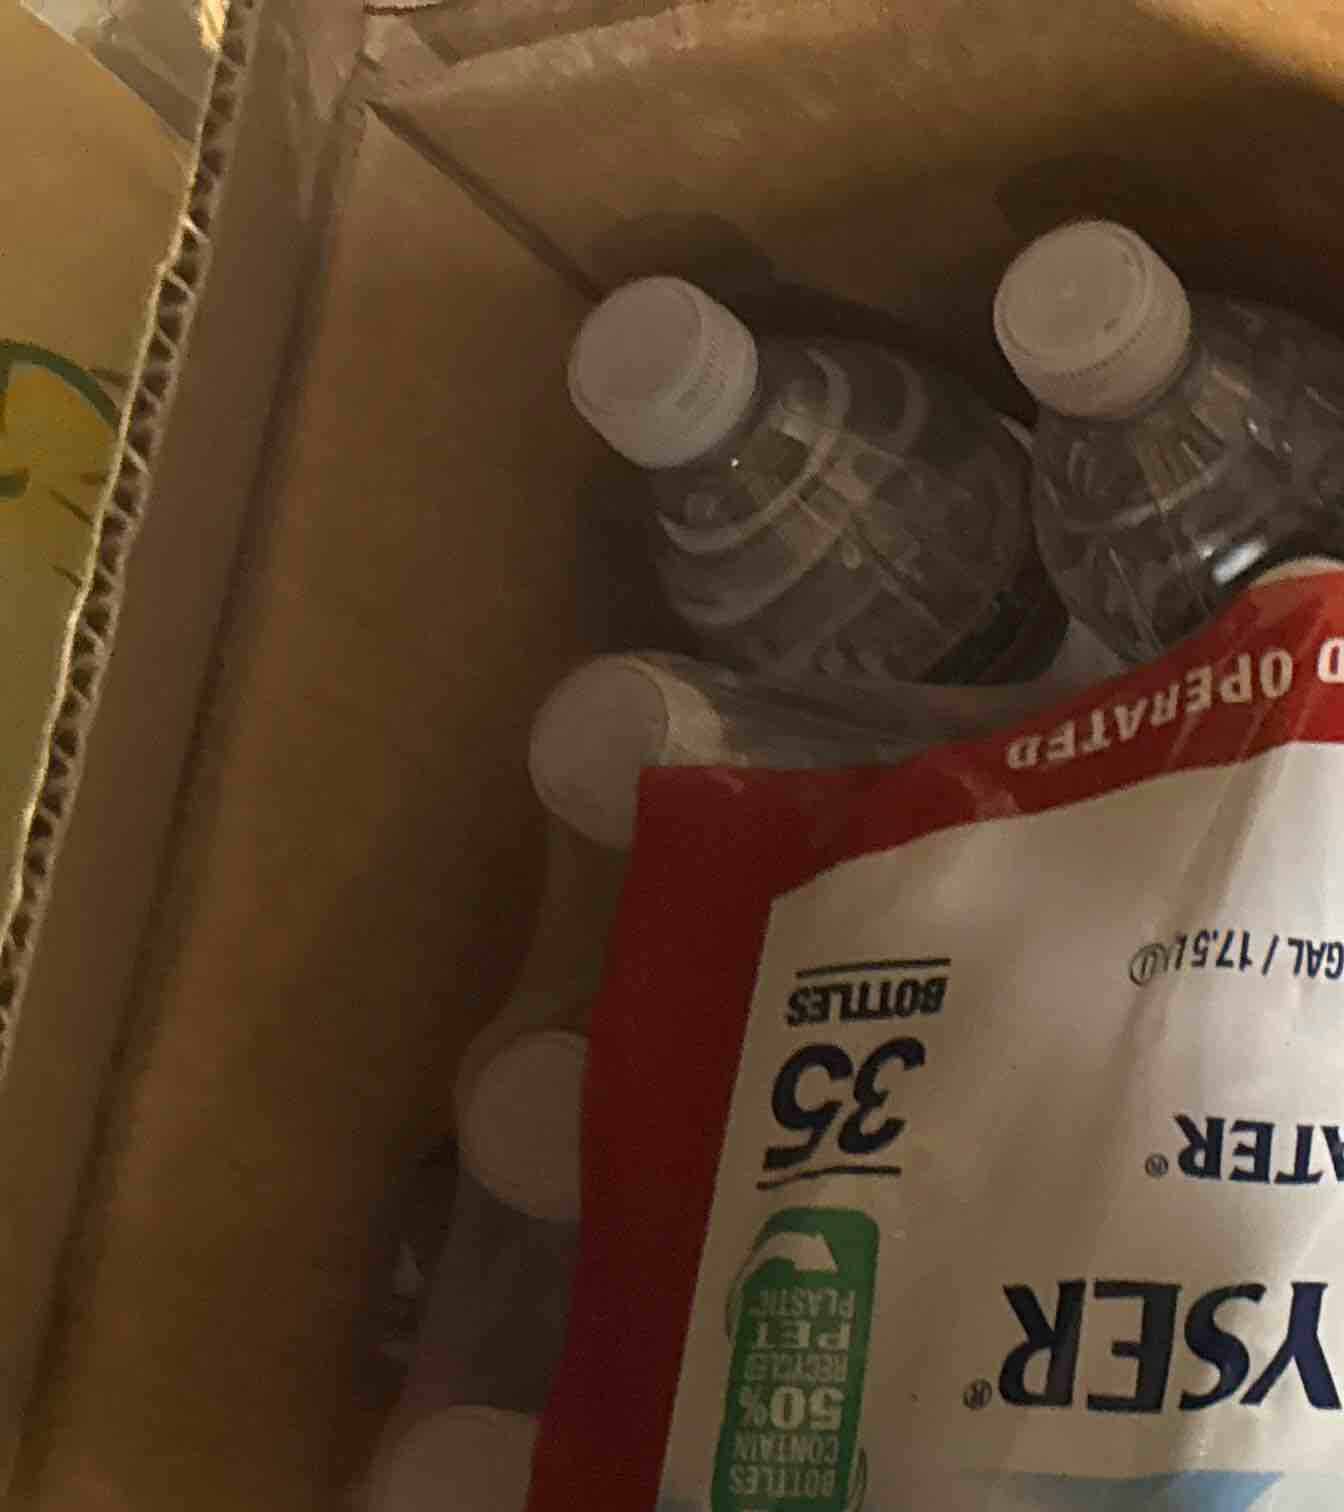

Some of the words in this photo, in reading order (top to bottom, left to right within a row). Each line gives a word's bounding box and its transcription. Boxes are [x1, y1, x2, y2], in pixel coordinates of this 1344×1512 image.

[1006, 646, 1294, 770] OPERATED
[786, 975, 948, 1028] BOTTLES
[762, 1035, 927, 1173] 35
[752, 1319, 851, 1350] PET
[738, 1385, 845, 1432] 50%
[728, 1464, 836, 1498] BOTTLES
